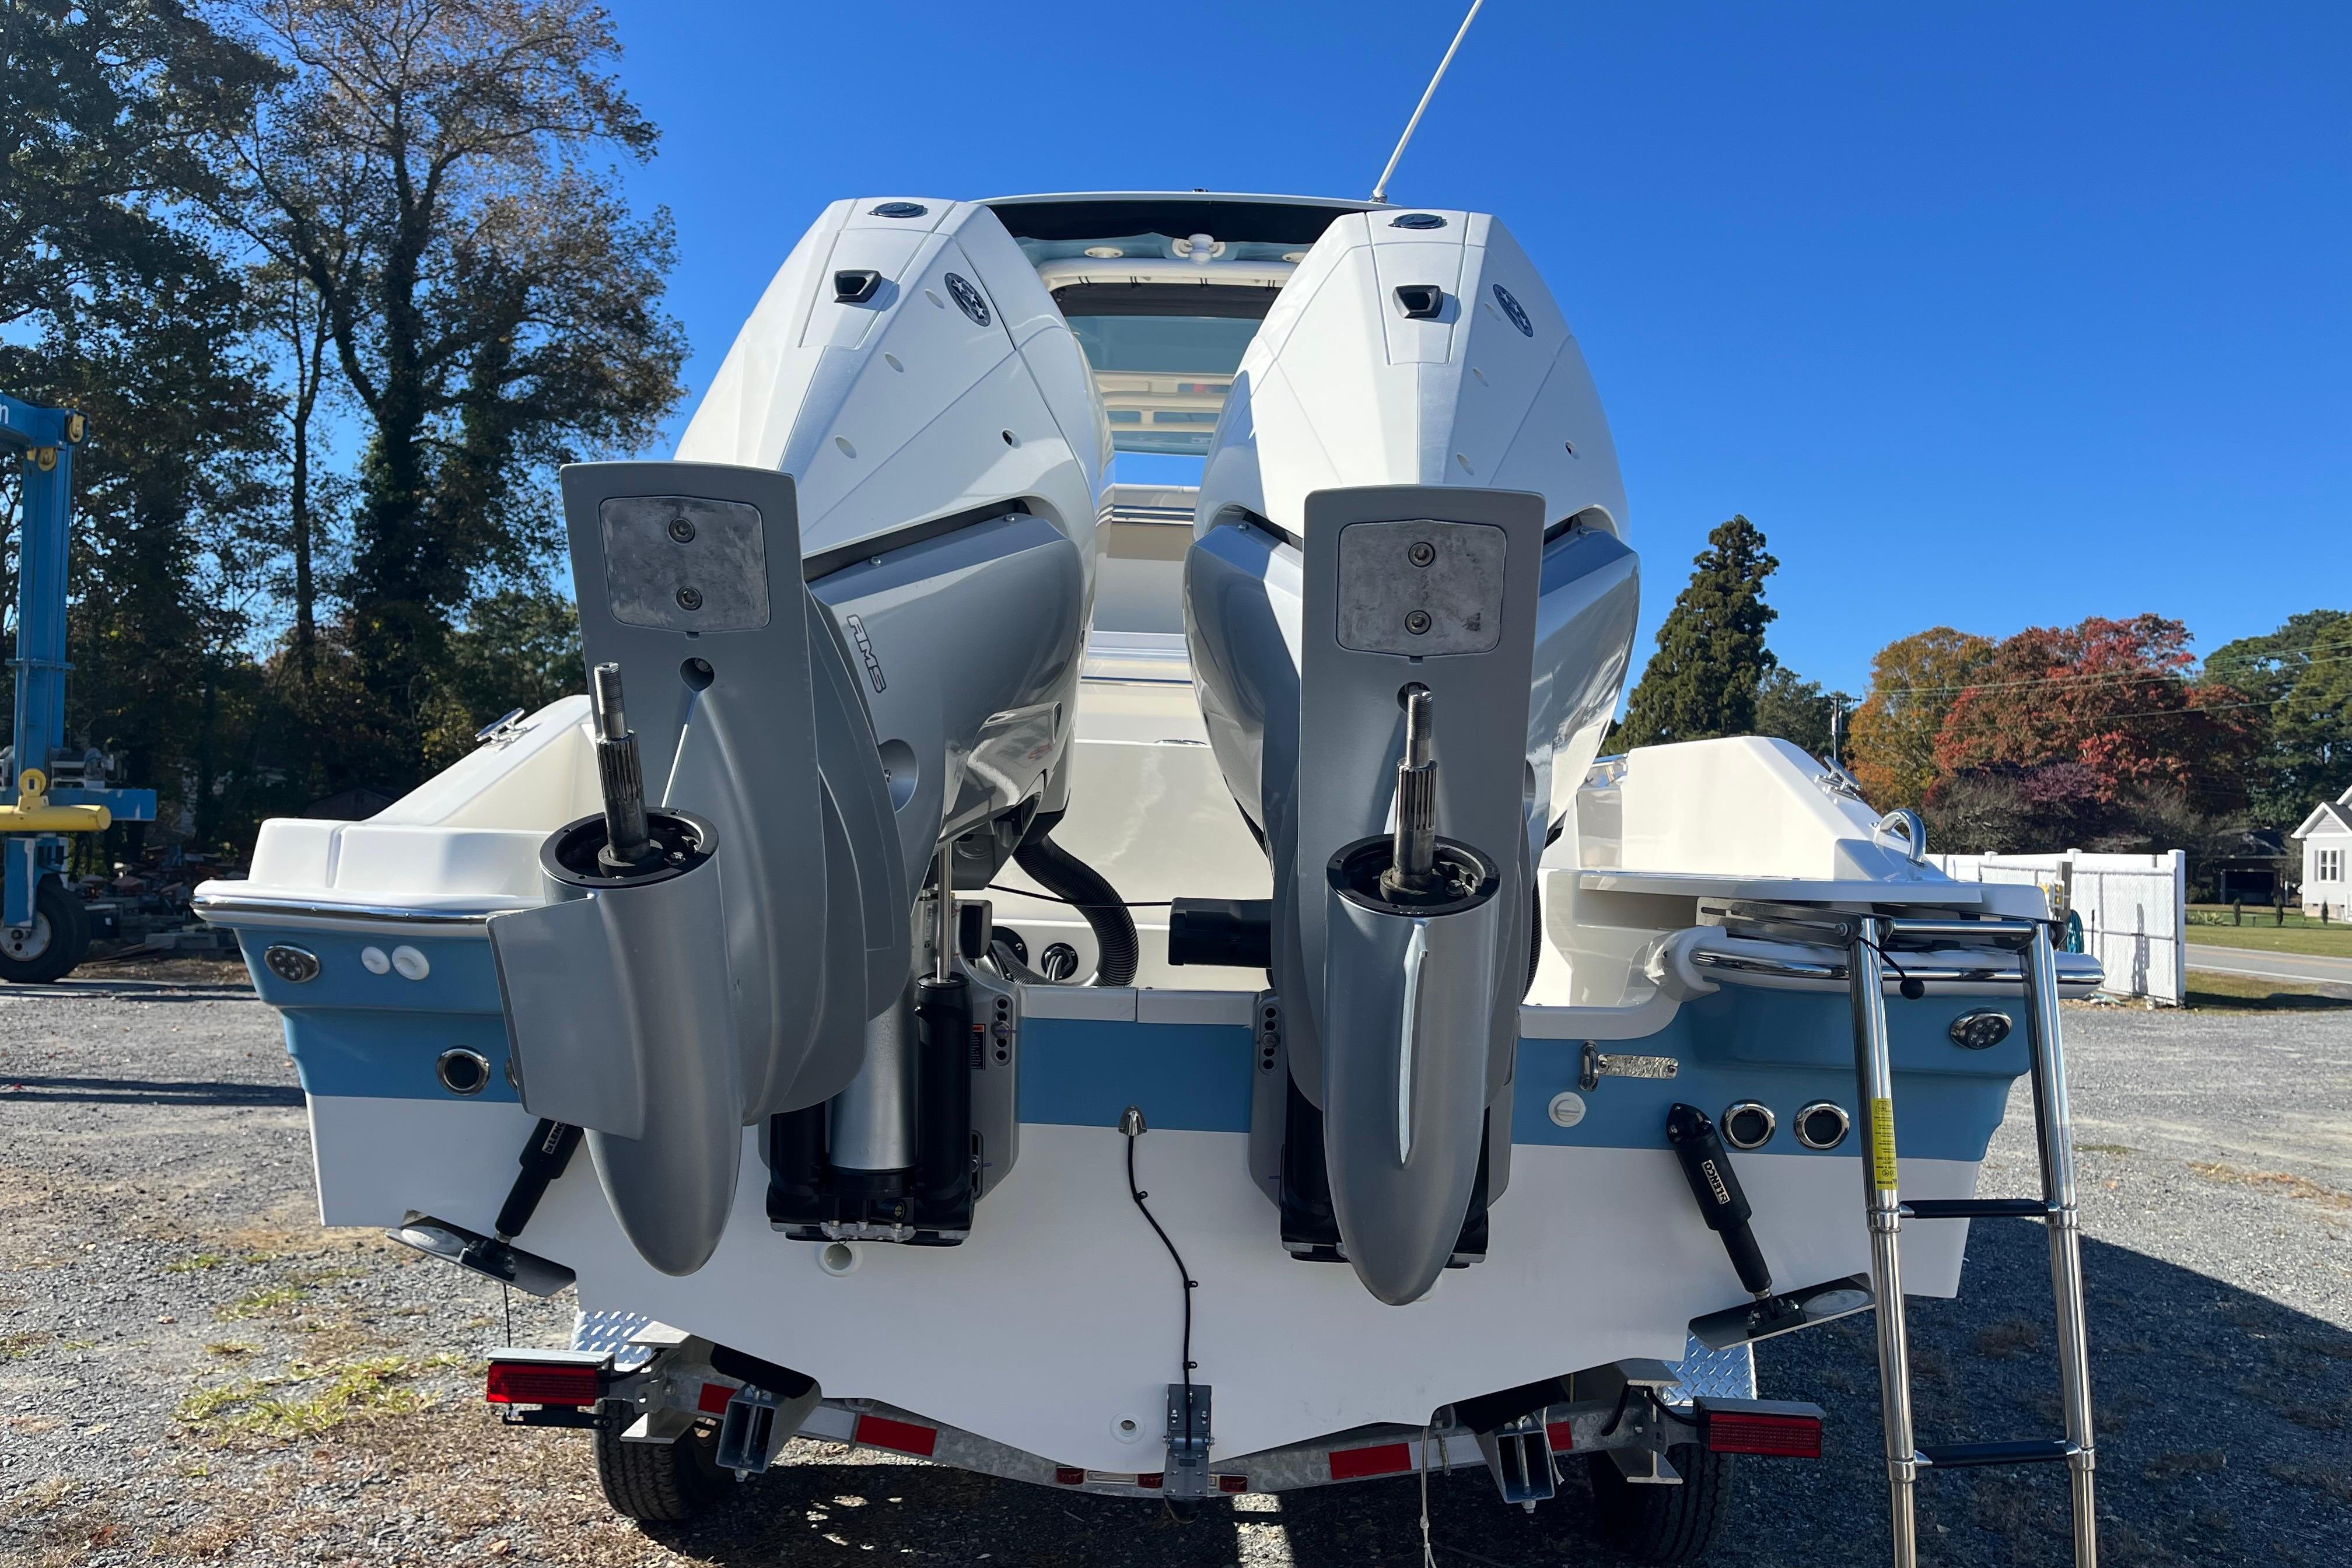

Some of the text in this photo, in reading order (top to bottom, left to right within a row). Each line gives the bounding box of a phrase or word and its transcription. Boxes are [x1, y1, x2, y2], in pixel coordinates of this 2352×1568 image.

[846, 614, 887, 694] AMS
[548, 1121, 564, 1144] LENC
[1704, 1161, 1724, 1195] LENCO
